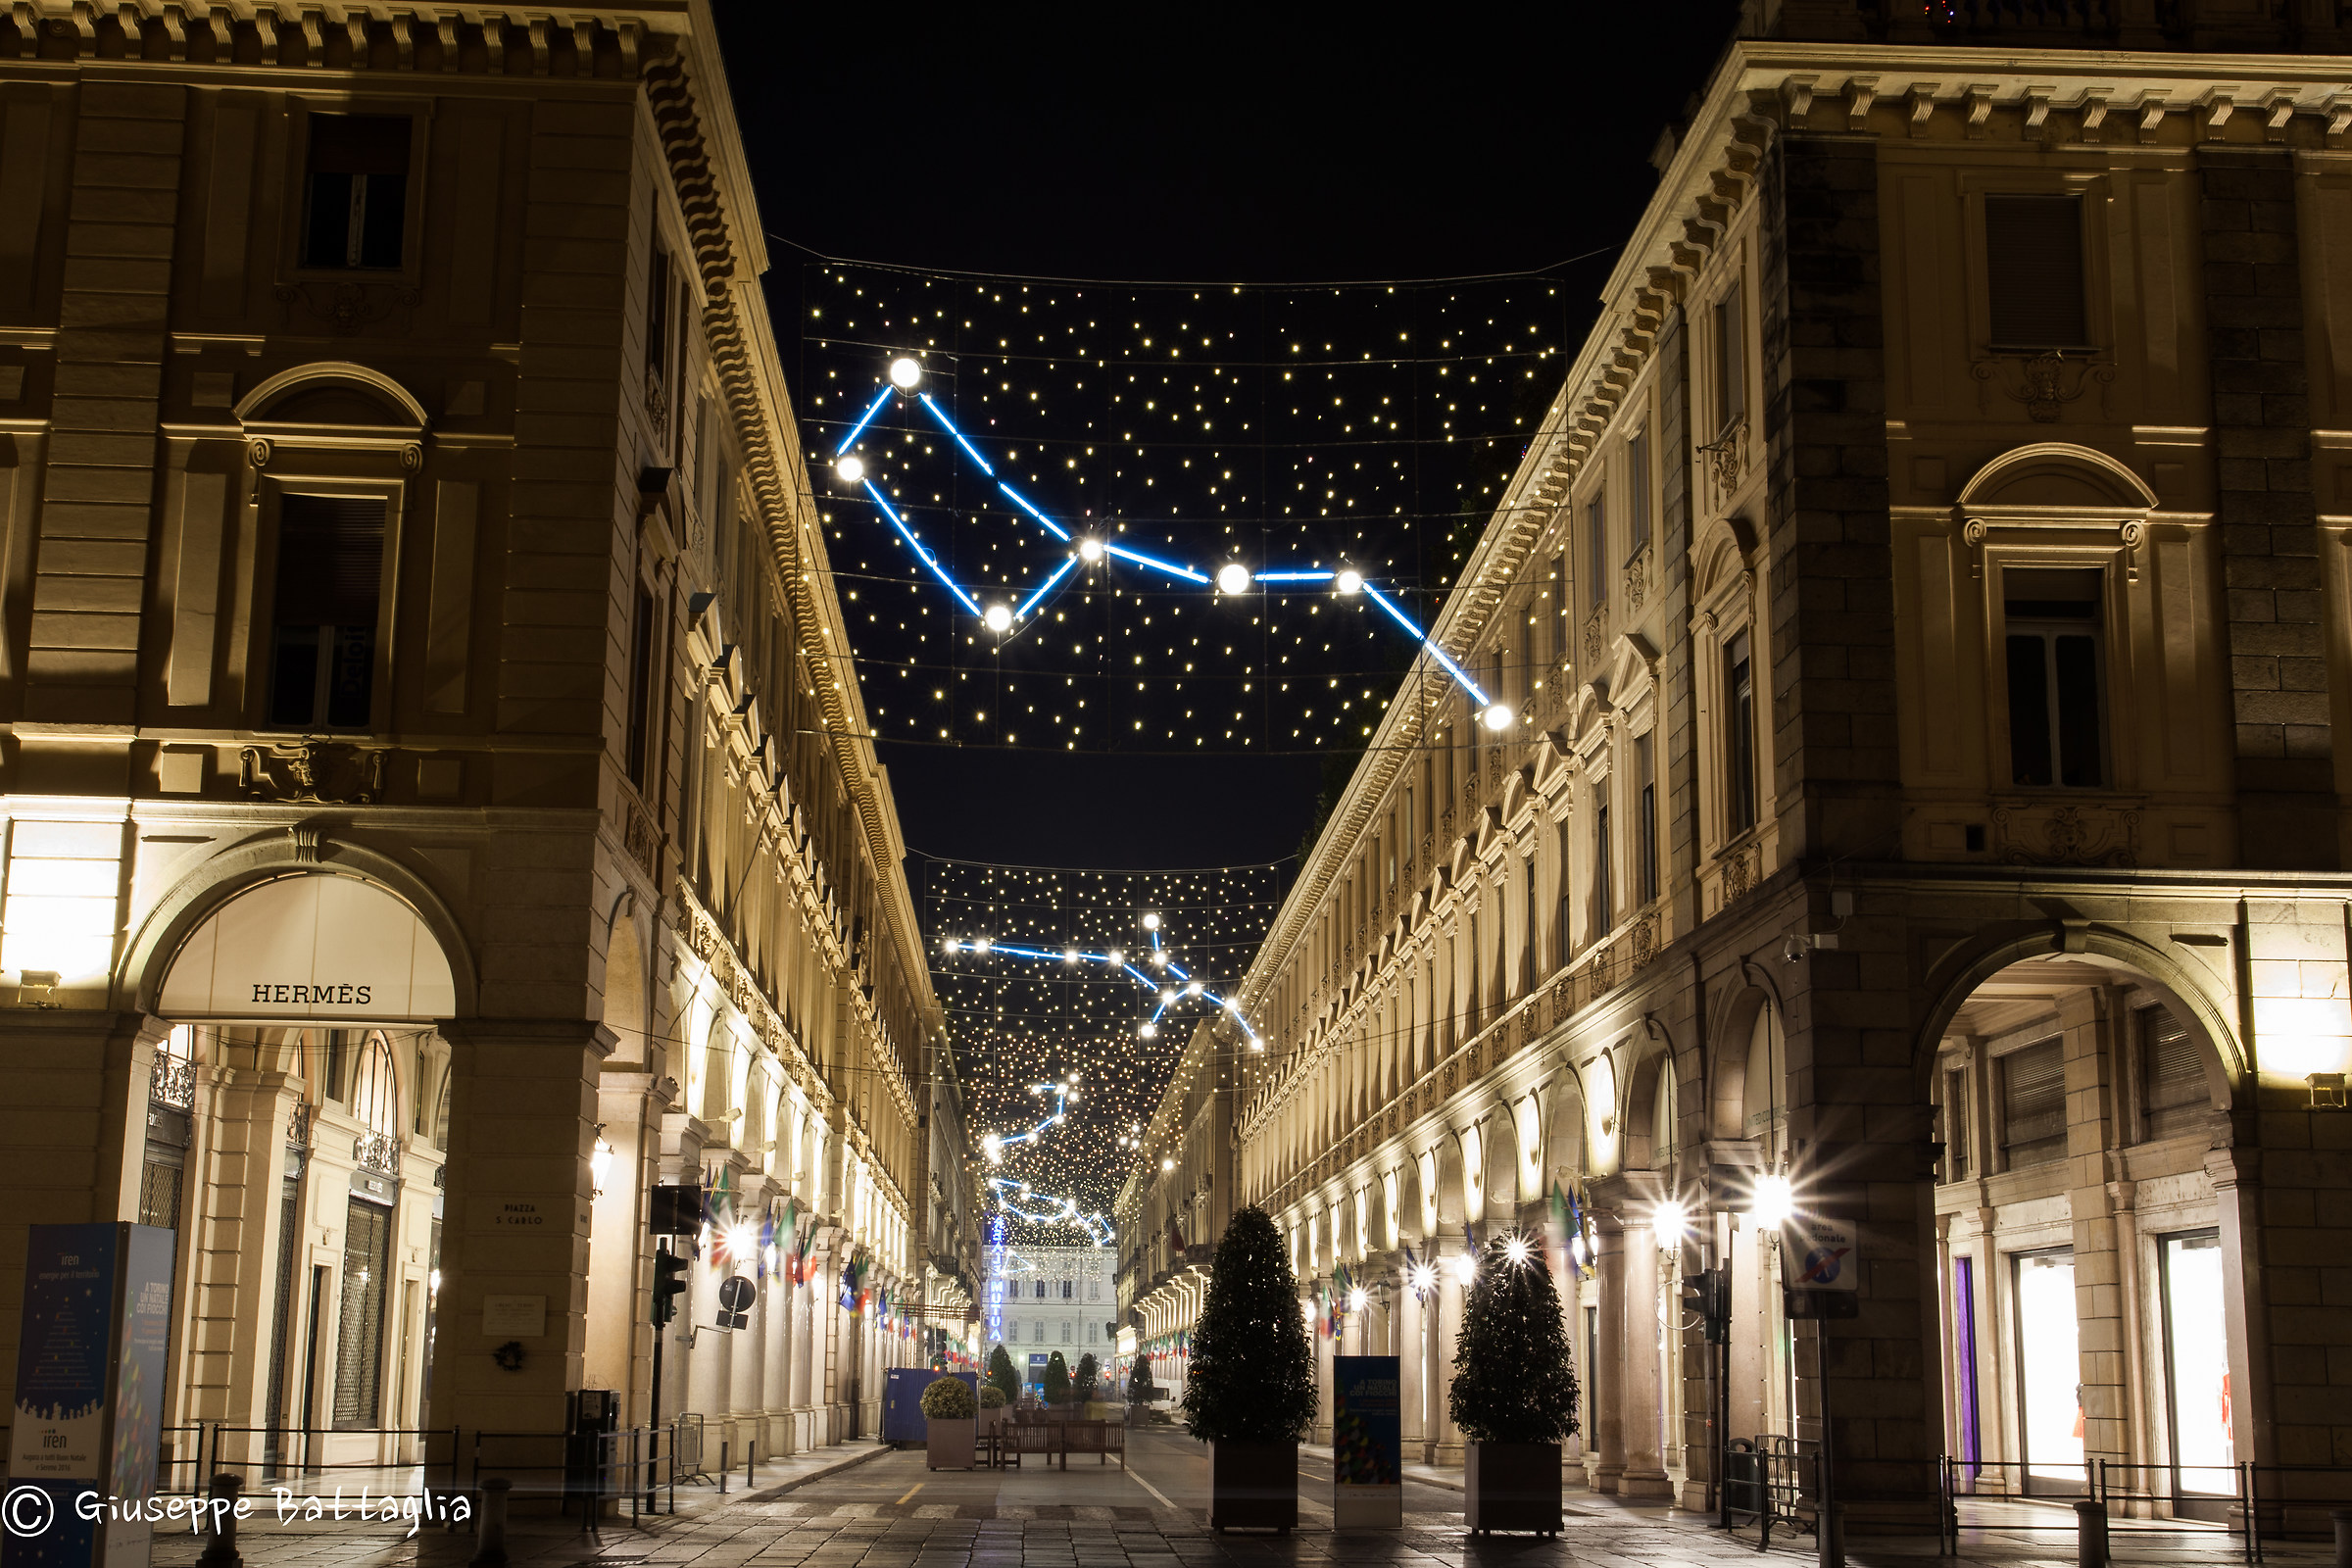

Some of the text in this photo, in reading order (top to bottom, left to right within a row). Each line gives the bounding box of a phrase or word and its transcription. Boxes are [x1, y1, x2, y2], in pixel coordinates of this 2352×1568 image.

[252, 983, 371, 1005] HERMÈS
[505, 1203, 535, 1212] PIAZZA
[508, 1215, 543, 1224] CARLO
[61, 1253, 79, 1266] iren
[144, 1282, 170, 1294] A TORINO
[149, 1293, 169, 1304] NATALE
[42, 1431, 67, 1448] iren
